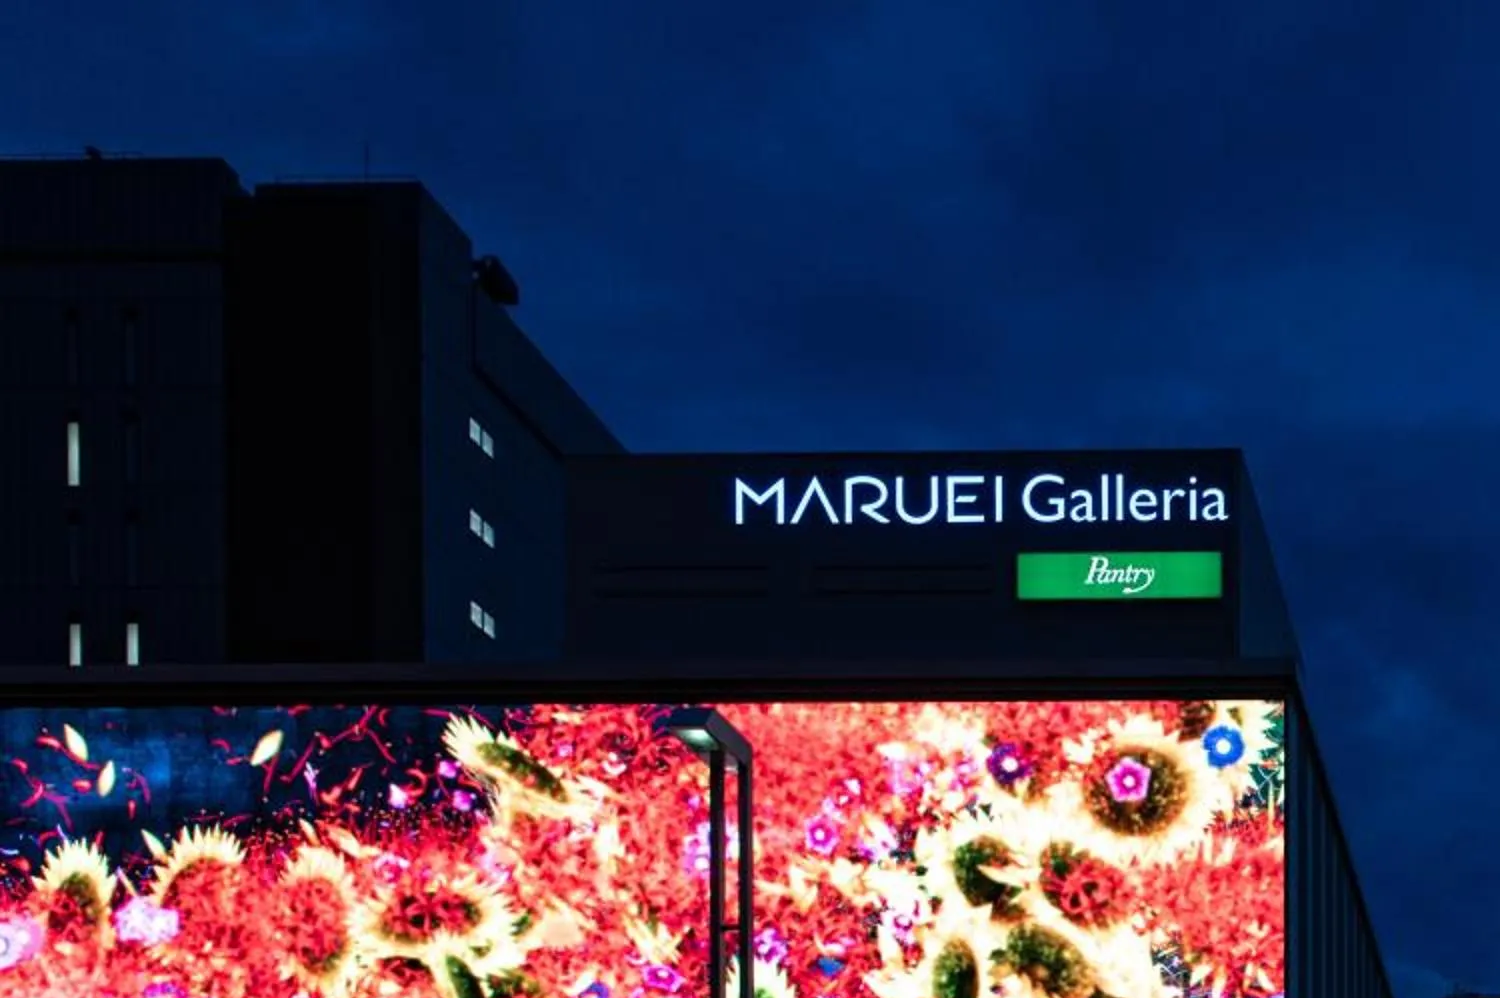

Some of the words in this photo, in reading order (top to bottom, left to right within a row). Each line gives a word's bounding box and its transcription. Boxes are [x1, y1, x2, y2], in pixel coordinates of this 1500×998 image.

[735, 475, 1003, 525] MARUEI
[1022, 474, 1230, 523] Galleria
[1084, 556, 1156, 594] Pantry
